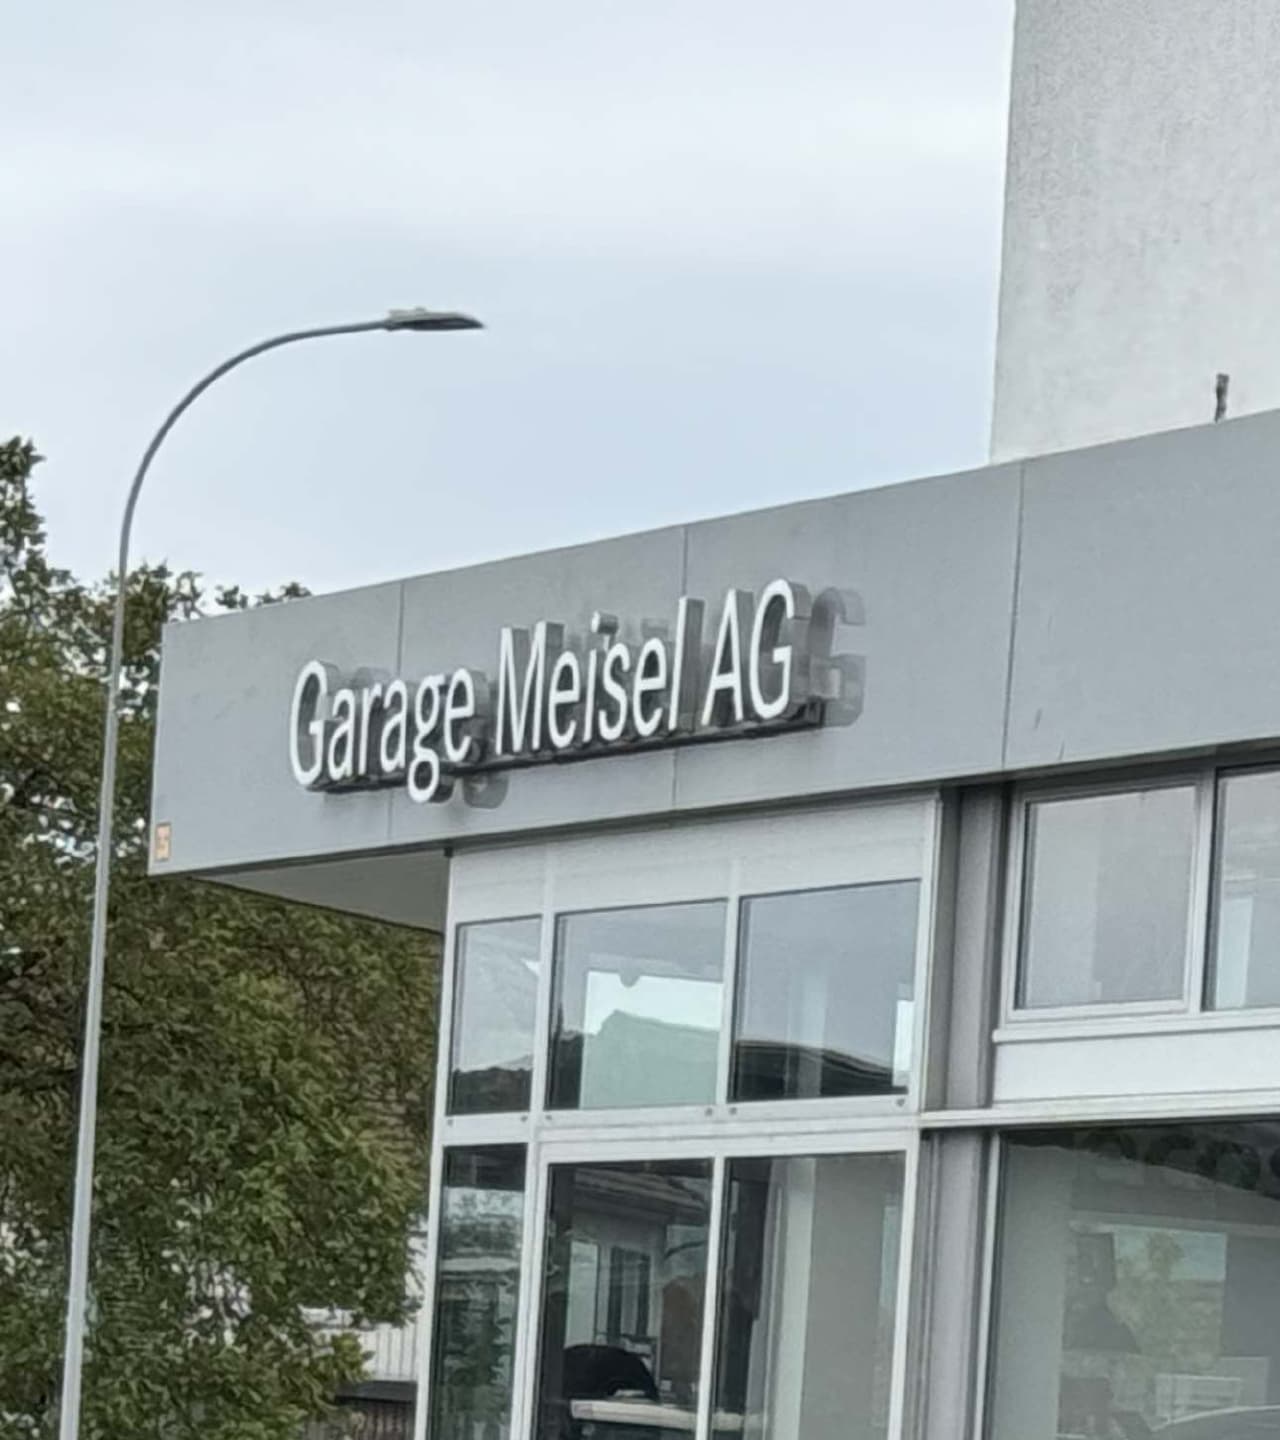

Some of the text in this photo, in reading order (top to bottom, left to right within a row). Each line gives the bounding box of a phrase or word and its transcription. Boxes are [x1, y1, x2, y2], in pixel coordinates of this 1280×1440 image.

[289, 578, 795, 803] Garage Meisel AG
